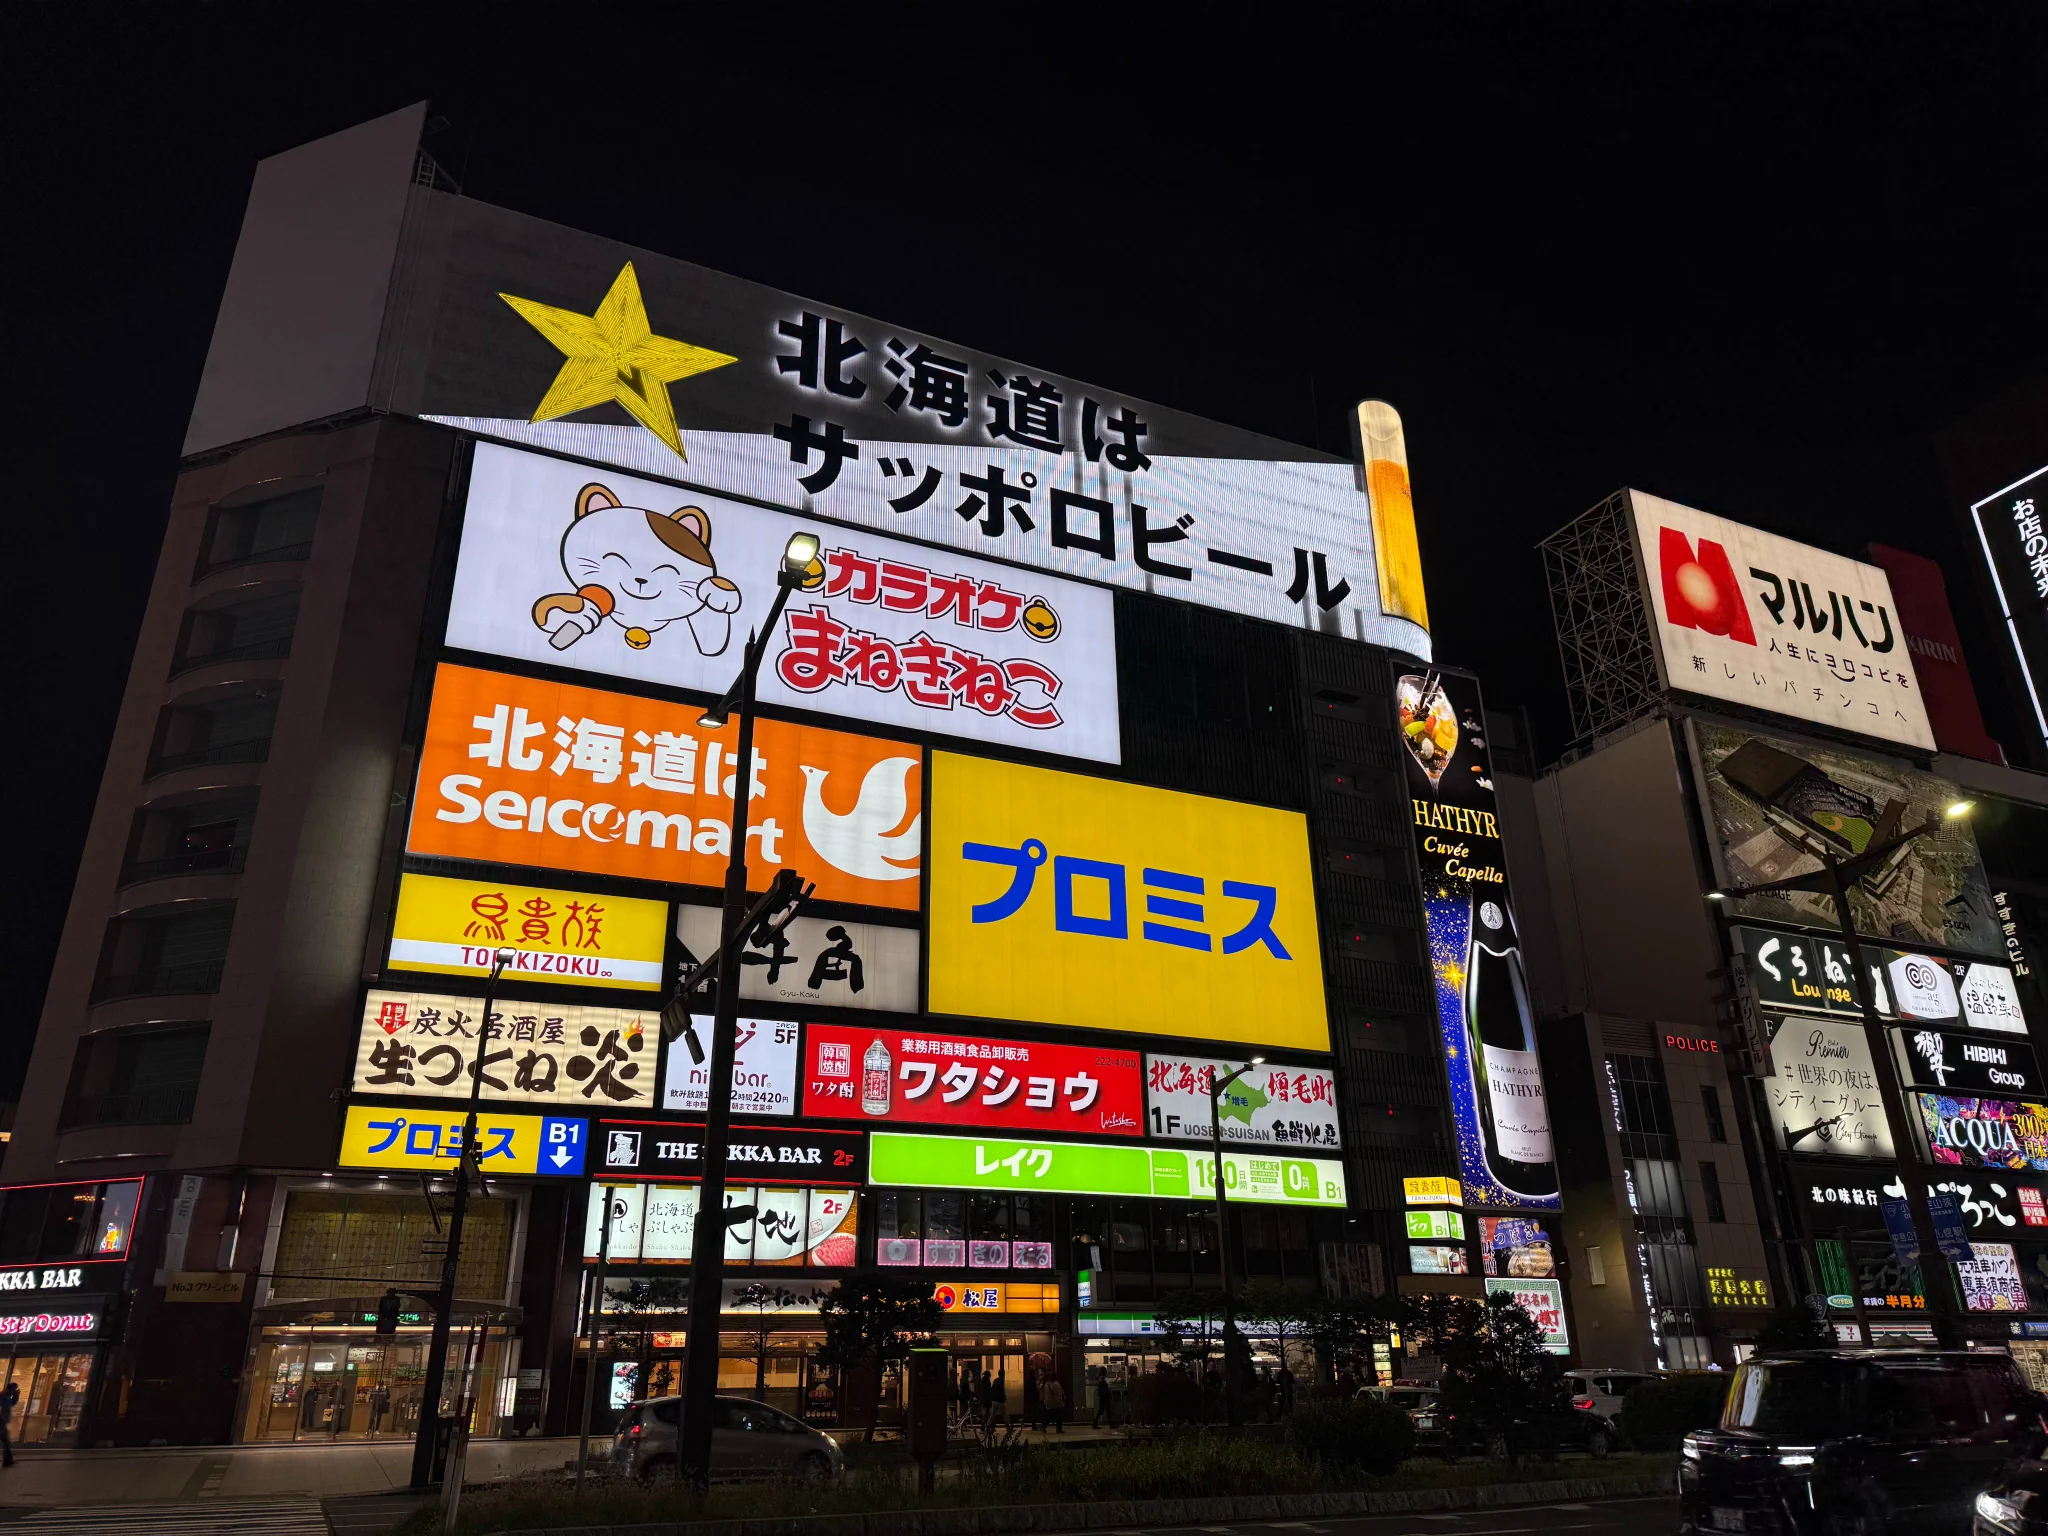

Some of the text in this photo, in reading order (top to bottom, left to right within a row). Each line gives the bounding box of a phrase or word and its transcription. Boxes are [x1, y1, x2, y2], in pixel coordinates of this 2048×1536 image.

[773, 310, 1152, 473] 北海道は
[773, 413, 1352, 615] サッポロビール
[820, 546, 1026, 638] カラオケ
[1748, 566, 1894, 654] マルハン
[774, 605, 1066, 730] まねきねこ
[1768, 638, 1910, 690] 人生にヨロコビを
[1691, 655, 1908, 723] 新しいパチンコへ
[468, 703, 768, 801] 北海道は
[435, 773, 784, 864] Seicomart
[1411, 799, 1500, 839] HATHYR
[1423, 835, 1470, 858] Cuvée
[1445, 858, 1504, 884] Capella
[963, 836, 1294, 962] プロミス
[463, 892, 605, 950] 鳥貴族
[461, 946, 600, 976] TOKIZOKU
[678, 961, 698, 971] 地下
[741, 922, 864, 994] 牛角
[1758, 937, 1856, 984] くろね
[1954, 964, 1965, 976] 2F
[780, 989, 820, 999] Gyu-Kaku
[1791, 977, 1852, 1003] Lounge
[382, 1003, 393, 1028] 1F
[393, 1005, 406, 1029] 当ビル
[409, 1007, 566, 1046] 炭火居酒屋
[774, 1028, 797, 1045] 5F
[1665, 1035, 1719, 1053] POLICE
[1805, 1029, 1850, 1059] Premier
[823, 1047, 846, 1060] 韓国
[901, 1038, 1029, 1062] 業務用酒類食品卸販売
[1963, 1044, 2007, 1066] HIBIKI
[364, 1037, 558, 1094] 生つくね
[823, 1060, 846, 1073] 焼酎
[1095, 1056, 1137, 1069] 222-4700
[1489, 1062, 1539, 1076] CHAMPAGNE
[812, 1081, 855, 1098] ワタ酎
[899, 1060, 1099, 1112] ワタショウ
[1149, 1059, 1217, 1096] 北海道
[1268, 1071, 1334, 1108] 増毛町
[1492, 1079, 1543, 1098] HATHYR
[1988, 1066, 2026, 1089] Group
[685, 1100, 773, 1111] 年中無 朝まで営業中
[1773, 1088, 1880, 1113] シティーグルー
[1150, 1106, 1181, 1134] 1F
[548, 1123, 580, 1144] B1
[1935, 1115, 2020, 1156] ACQUA
[655, 1141, 855, 1167] THE KKA BAR 2F
[975, 1145, 1053, 1178] レイク
[1250, 1160, 1279, 1171] はじめて
[1195, 1158, 1238, 1190] 180
[1325, 1181, 1343, 1199] B1
[1811, 1186, 1879, 1206] 北の味紀行
[649, 1202, 694, 1218] 北海道
[822, 1198, 843, 1215] 2F
[1409, 1214, 1428, 1233] レイク
[1435, 1225, 1448, 1236] B1
[608, 1241, 637, 1250] okkaido
[40, 1267, 82, 1289] BAR
[1958, 1257, 2009, 1276] 元祖串かつ
[961, 1287, 999, 1309] 松屋
[1885, 1294, 1925, 1309] 半月分
[364, 1313, 379, 1322] No.
